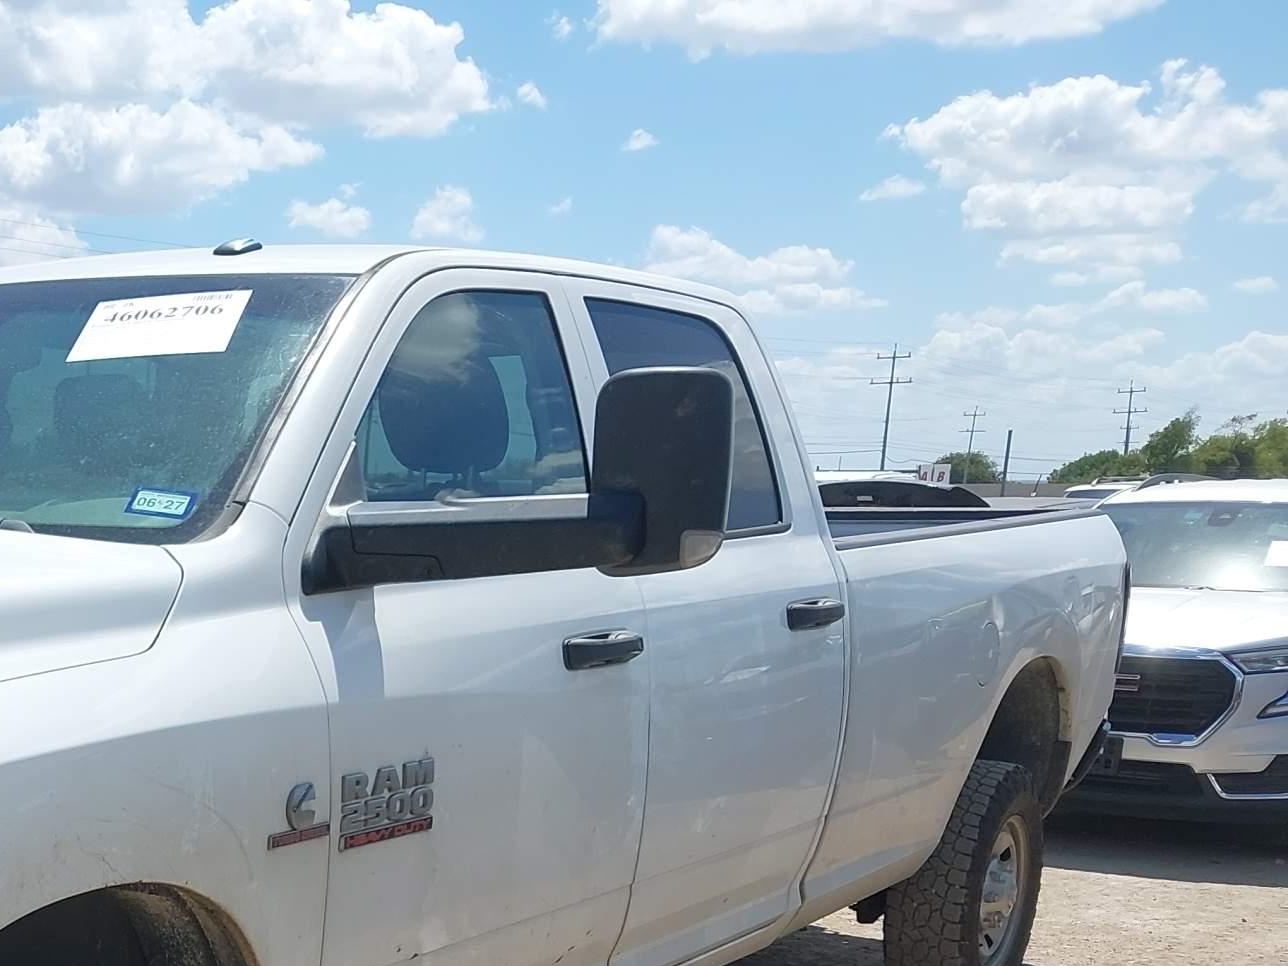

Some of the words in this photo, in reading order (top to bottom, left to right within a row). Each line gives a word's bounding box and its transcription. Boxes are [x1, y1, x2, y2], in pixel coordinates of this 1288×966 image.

[103, 303, 224, 324] 46062706
[936, 471, 945, 482] B
[341, 757, 435, 803] RAM
[340, 786, 434, 833] 2500
[345, 827, 393, 848] HEAVY
[394, 818, 430, 837] DUTY
